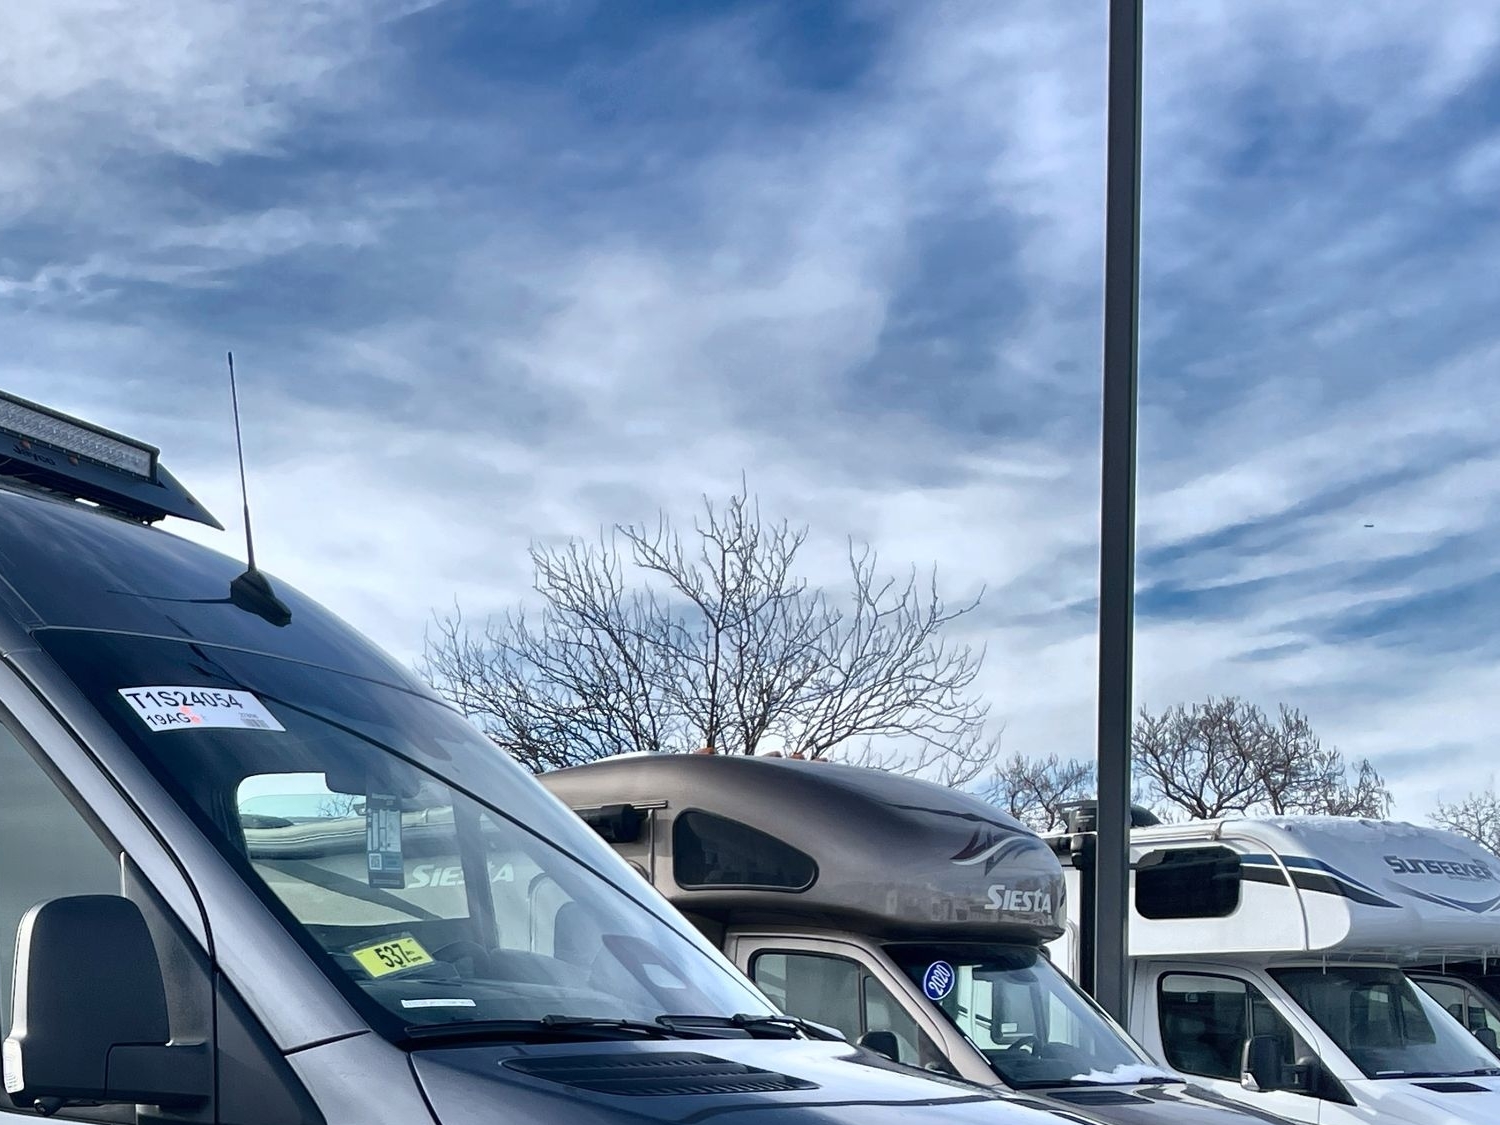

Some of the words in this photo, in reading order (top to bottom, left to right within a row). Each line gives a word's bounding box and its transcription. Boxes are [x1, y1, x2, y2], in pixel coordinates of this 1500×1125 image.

[125, 691, 244, 710] T1S24054
[984, 884, 1052, 914] SIESTA
[373, 943, 411, 968] 537
[927, 964, 952, 996] 2020
